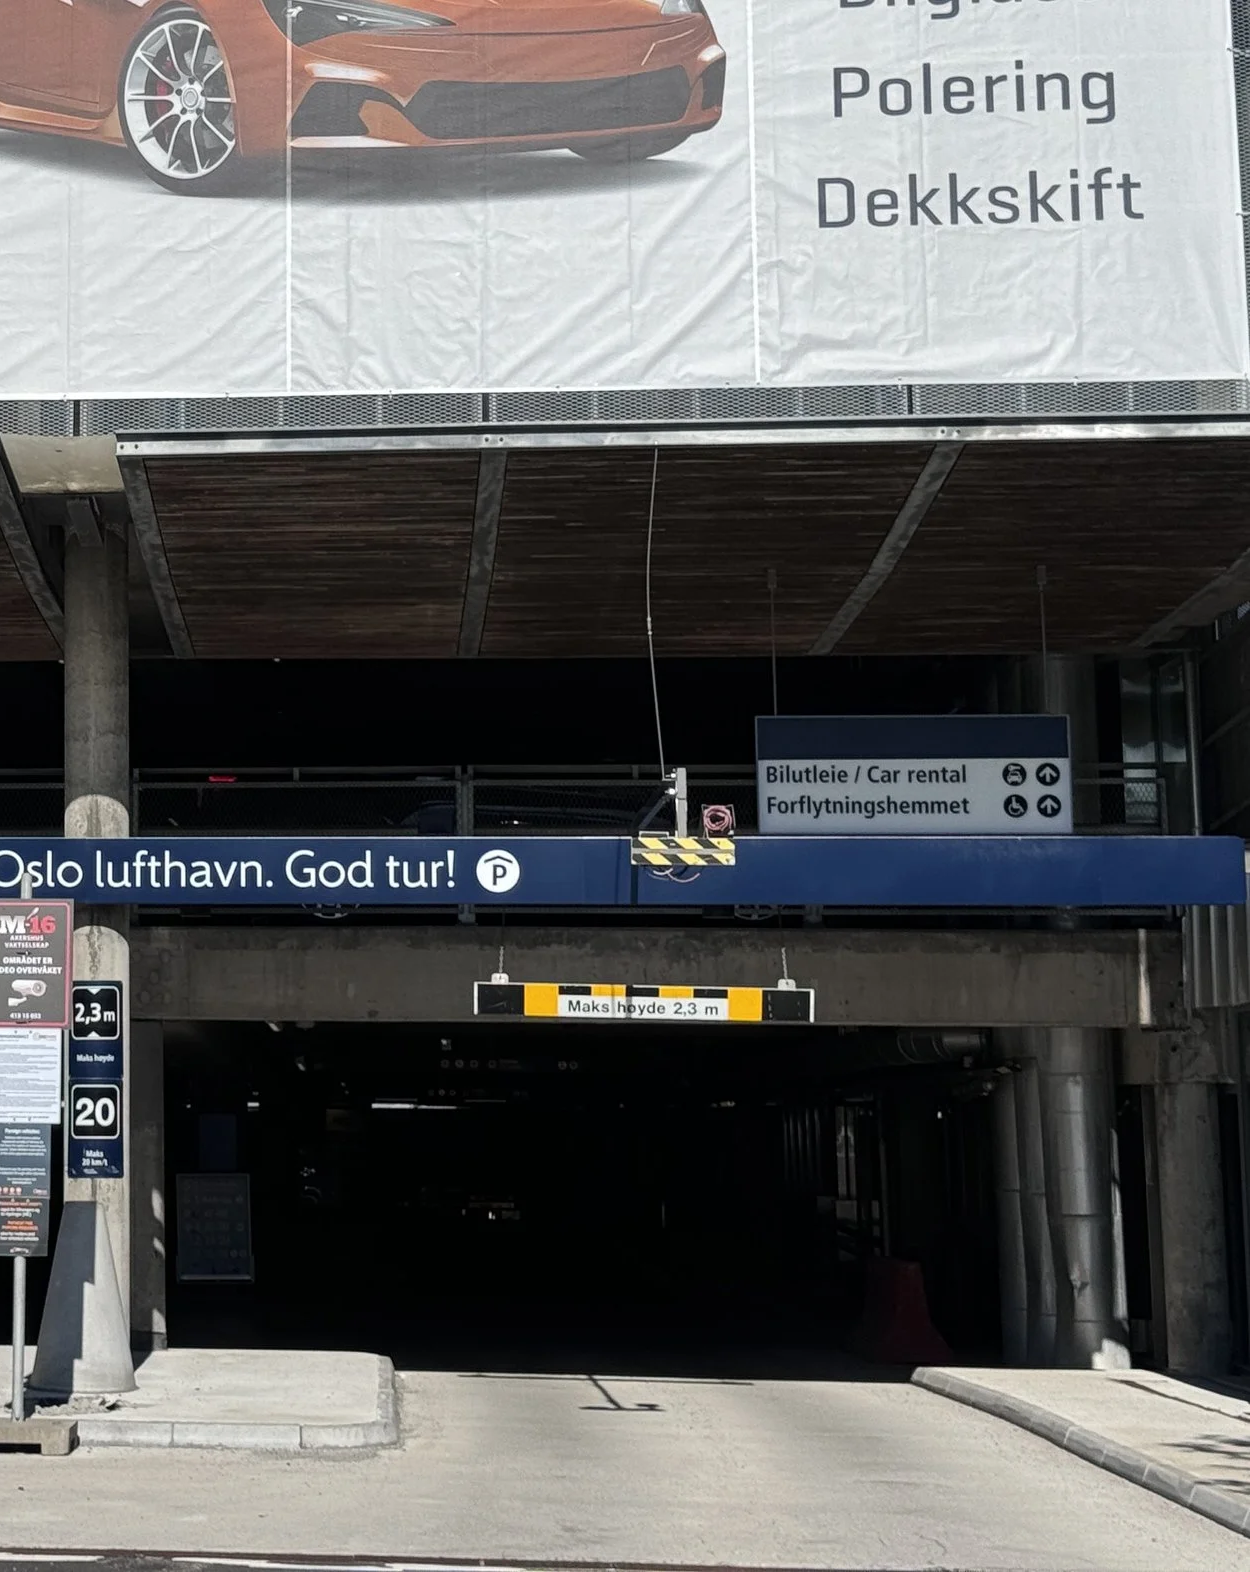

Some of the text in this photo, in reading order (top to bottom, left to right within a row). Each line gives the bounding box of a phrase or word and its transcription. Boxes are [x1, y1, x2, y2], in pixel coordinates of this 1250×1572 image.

[833, 60, 1116, 125] Polering
[817, 167, 1144, 229] Dekkskift
[766, 764, 967, 784] Bilutleie / Car rental
[766, 795, 970, 819] Forflytningshemmet
[95, 850, 274, 889] lufthavn.
[285, 850, 374, 889] God
[385, 850, 456, 889] tur!
[2, 955, 53, 964] OMRÅDET ER
[16, 965, 63, 975] OVERVÅKET
[74, 1002, 116, 1026] 2,3 m
[568, 1000, 610, 1013] Maks
[673, 1002, 697, 1017] 2,3
[704, 1005, 719, 1016] m
[75, 1097, 116, 1127] 20
[81, 1157, 91, 1167] 20
[85, 1149, 104, 1158] Maks
